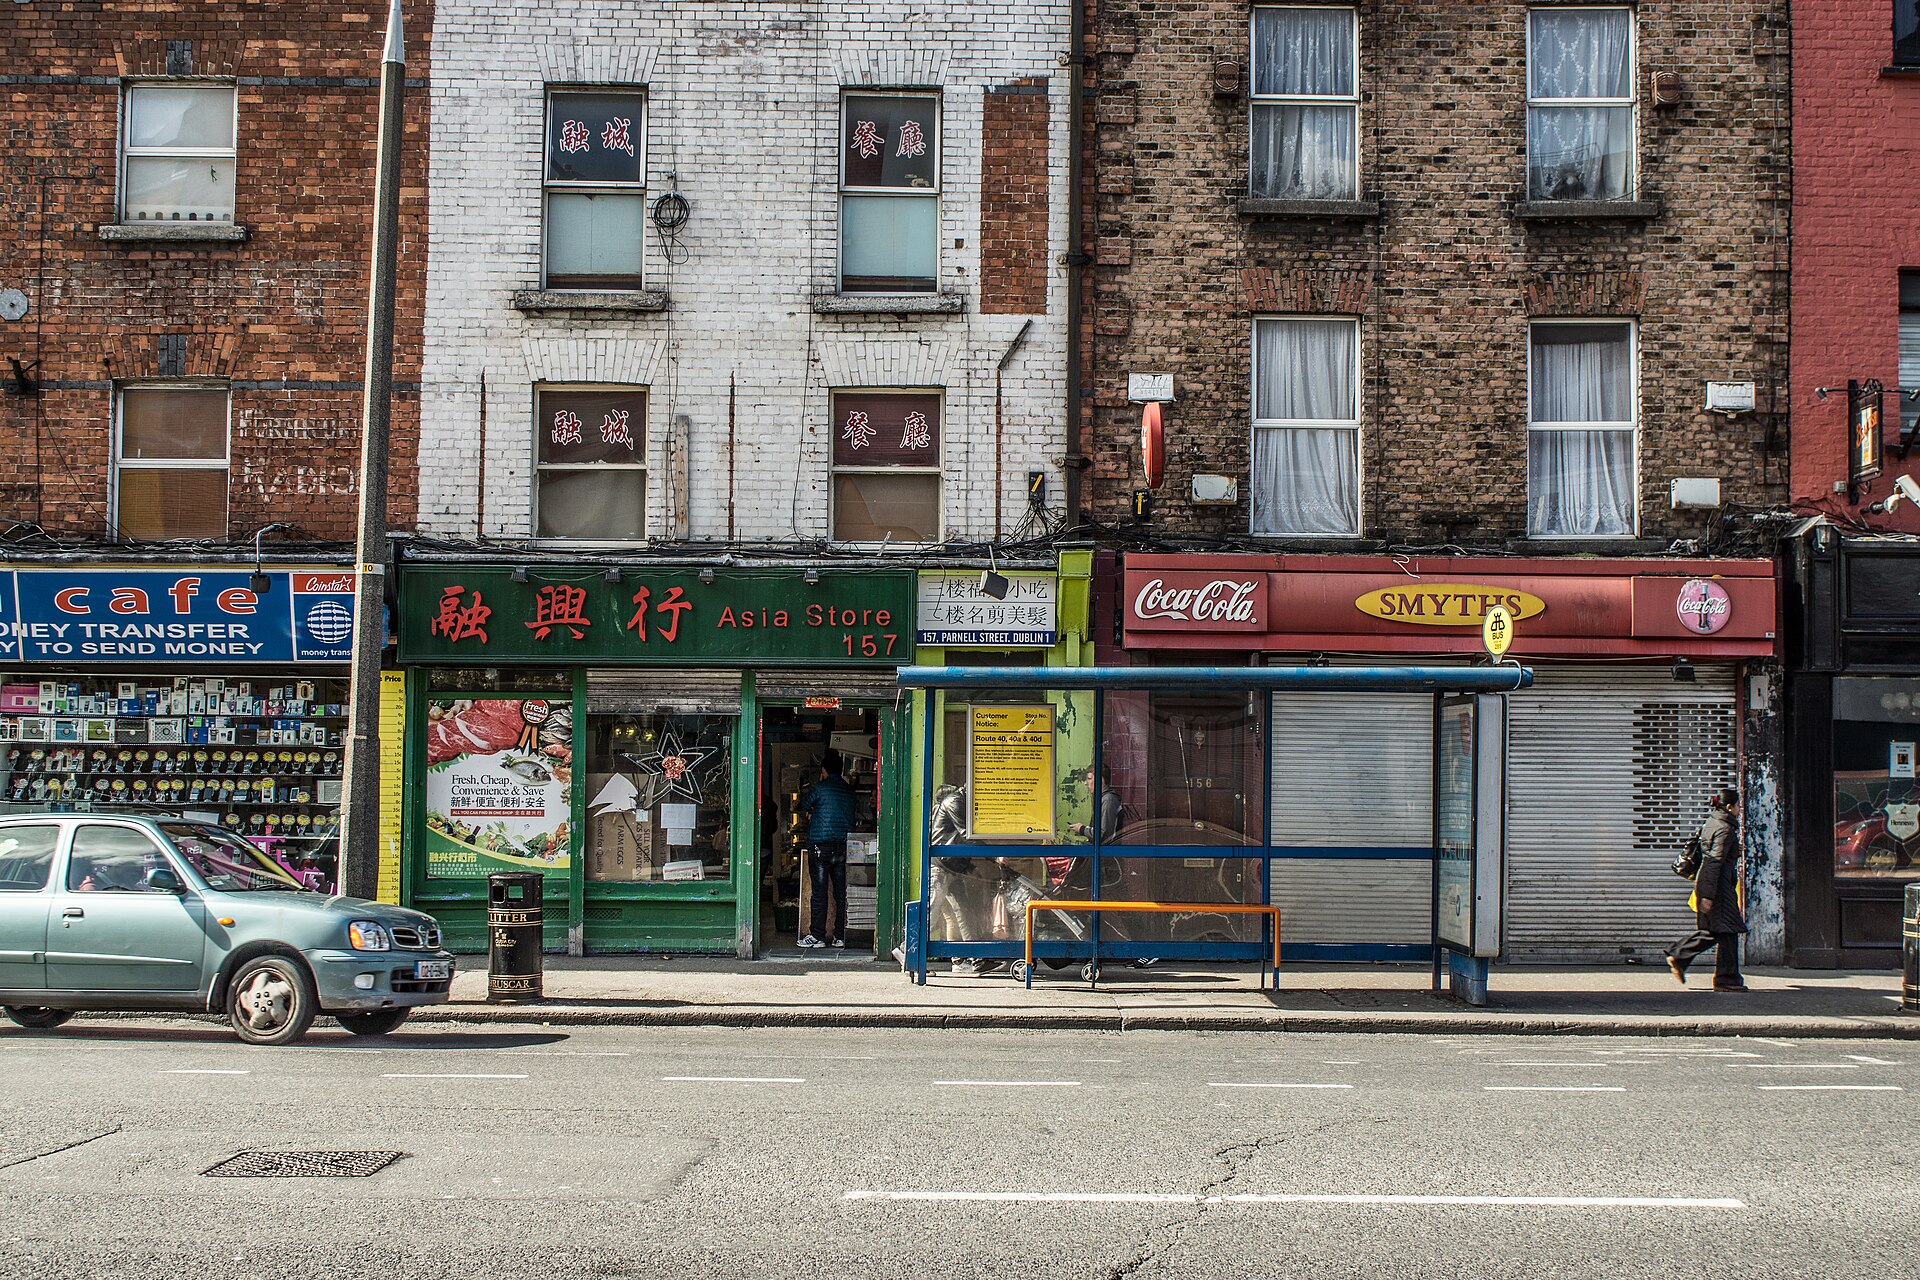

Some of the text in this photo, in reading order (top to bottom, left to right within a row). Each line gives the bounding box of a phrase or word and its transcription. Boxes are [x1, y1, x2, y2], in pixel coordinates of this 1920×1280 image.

[306, 576, 350, 592] Coinstar
[54, 577, 258, 614] cafe
[1134, 578, 1259, 623] Coca-Cola
[1380, 593, 1521, 617] SMYTHS
[431, 584, 693, 644] 融興行
[717, 604, 892, 628] Asia Store
[78, 623, 250, 639] TRANSFER
[923, 632, 939, 644] 157,
[941, 632, 977, 643] PARNELL
[1013, 632, 1043, 643] DUBLIN
[1045, 632, 1050, 643] 1
[1492, 631, 1504, 640] BUS
[35, 642, 73, 654] TO
[81, 642, 158, 654] SEND
[165, 642, 264, 655] MONEY
[301, 649, 329, 658] money
[842, 634, 898, 657] 157
[525, 702, 548, 714] Fresh
[451, 774, 513, 787] Fresh, Cheap,
[1190, 778, 1212, 788] 156
[451, 785, 545, 796] Convenience & Save
[595, 816, 605, 873] Tested for Quality
[616, 825, 625, 865] FARM EGGS
[636, 834, 643, 842] IN
